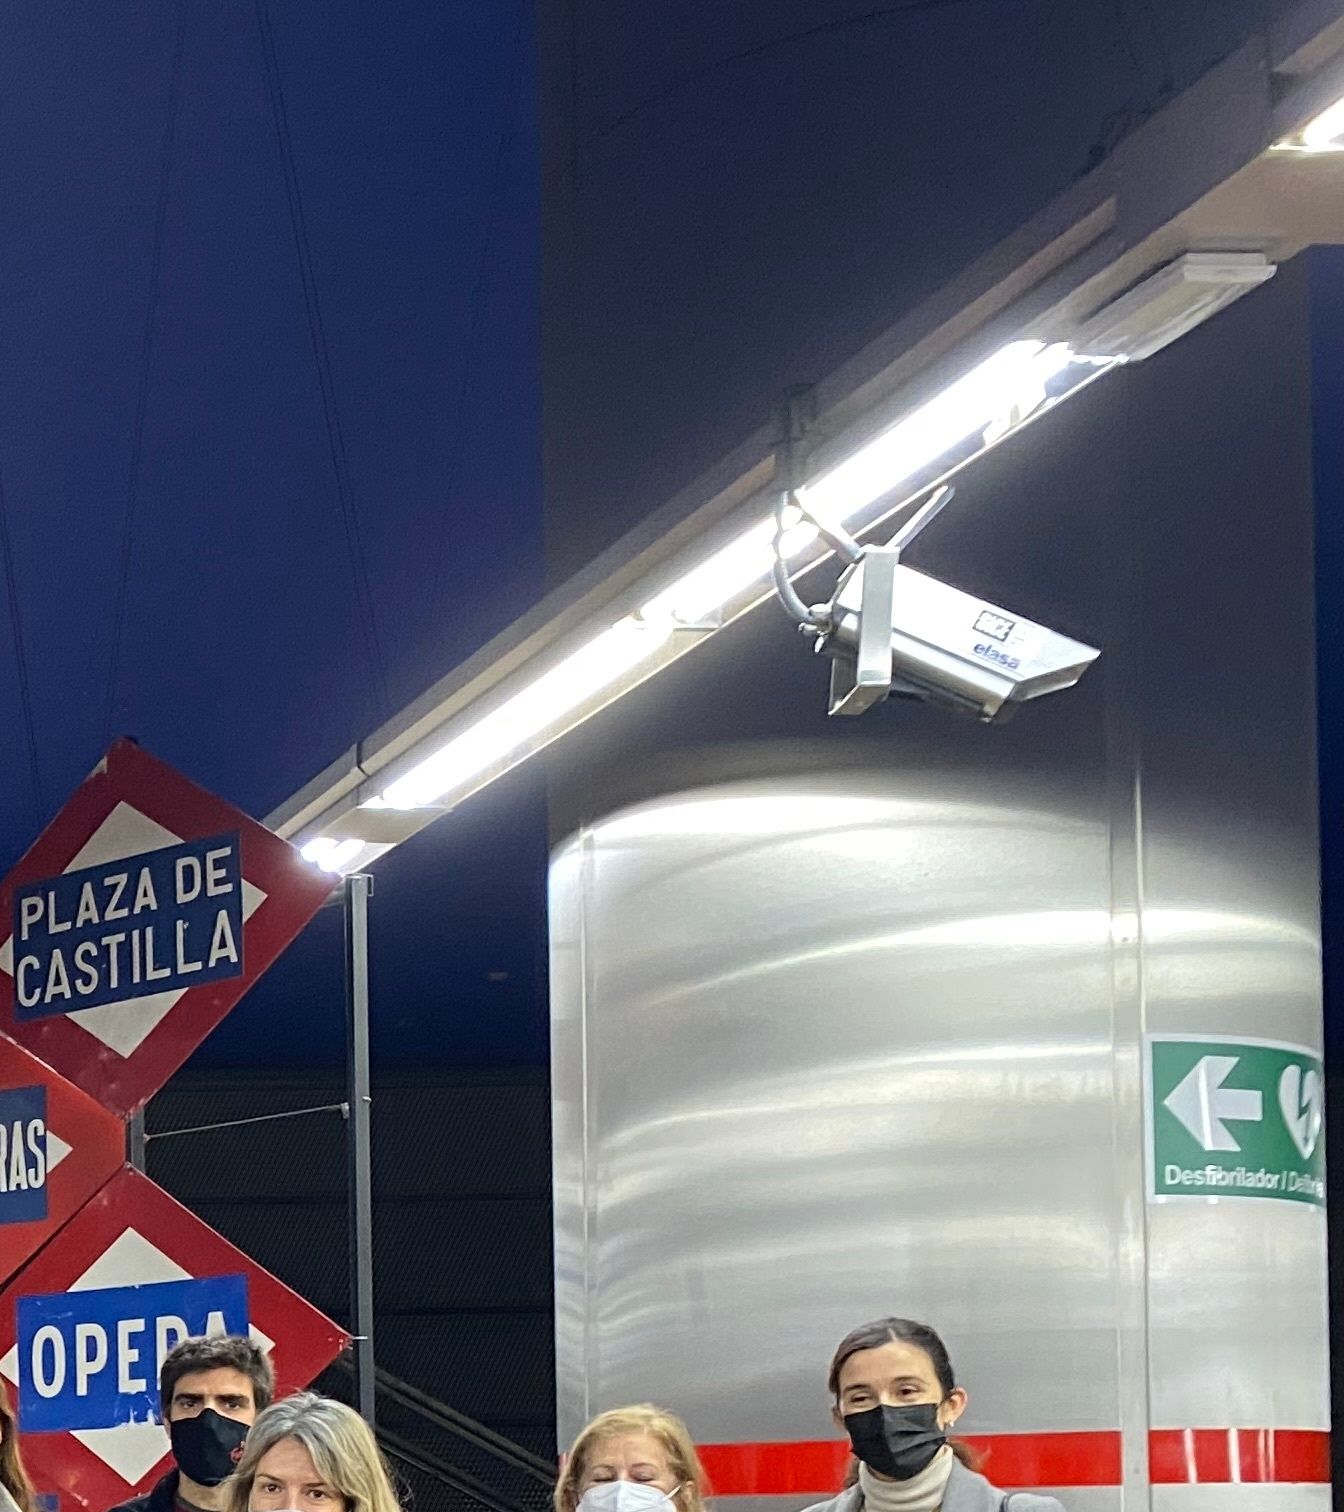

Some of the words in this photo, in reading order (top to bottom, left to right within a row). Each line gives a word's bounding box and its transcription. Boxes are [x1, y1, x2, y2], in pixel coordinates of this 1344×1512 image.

[20, 869, 158, 940] PLAZA
[175, 847, 234, 901] DE
[16, 909, 238, 1008] CASTILLA
